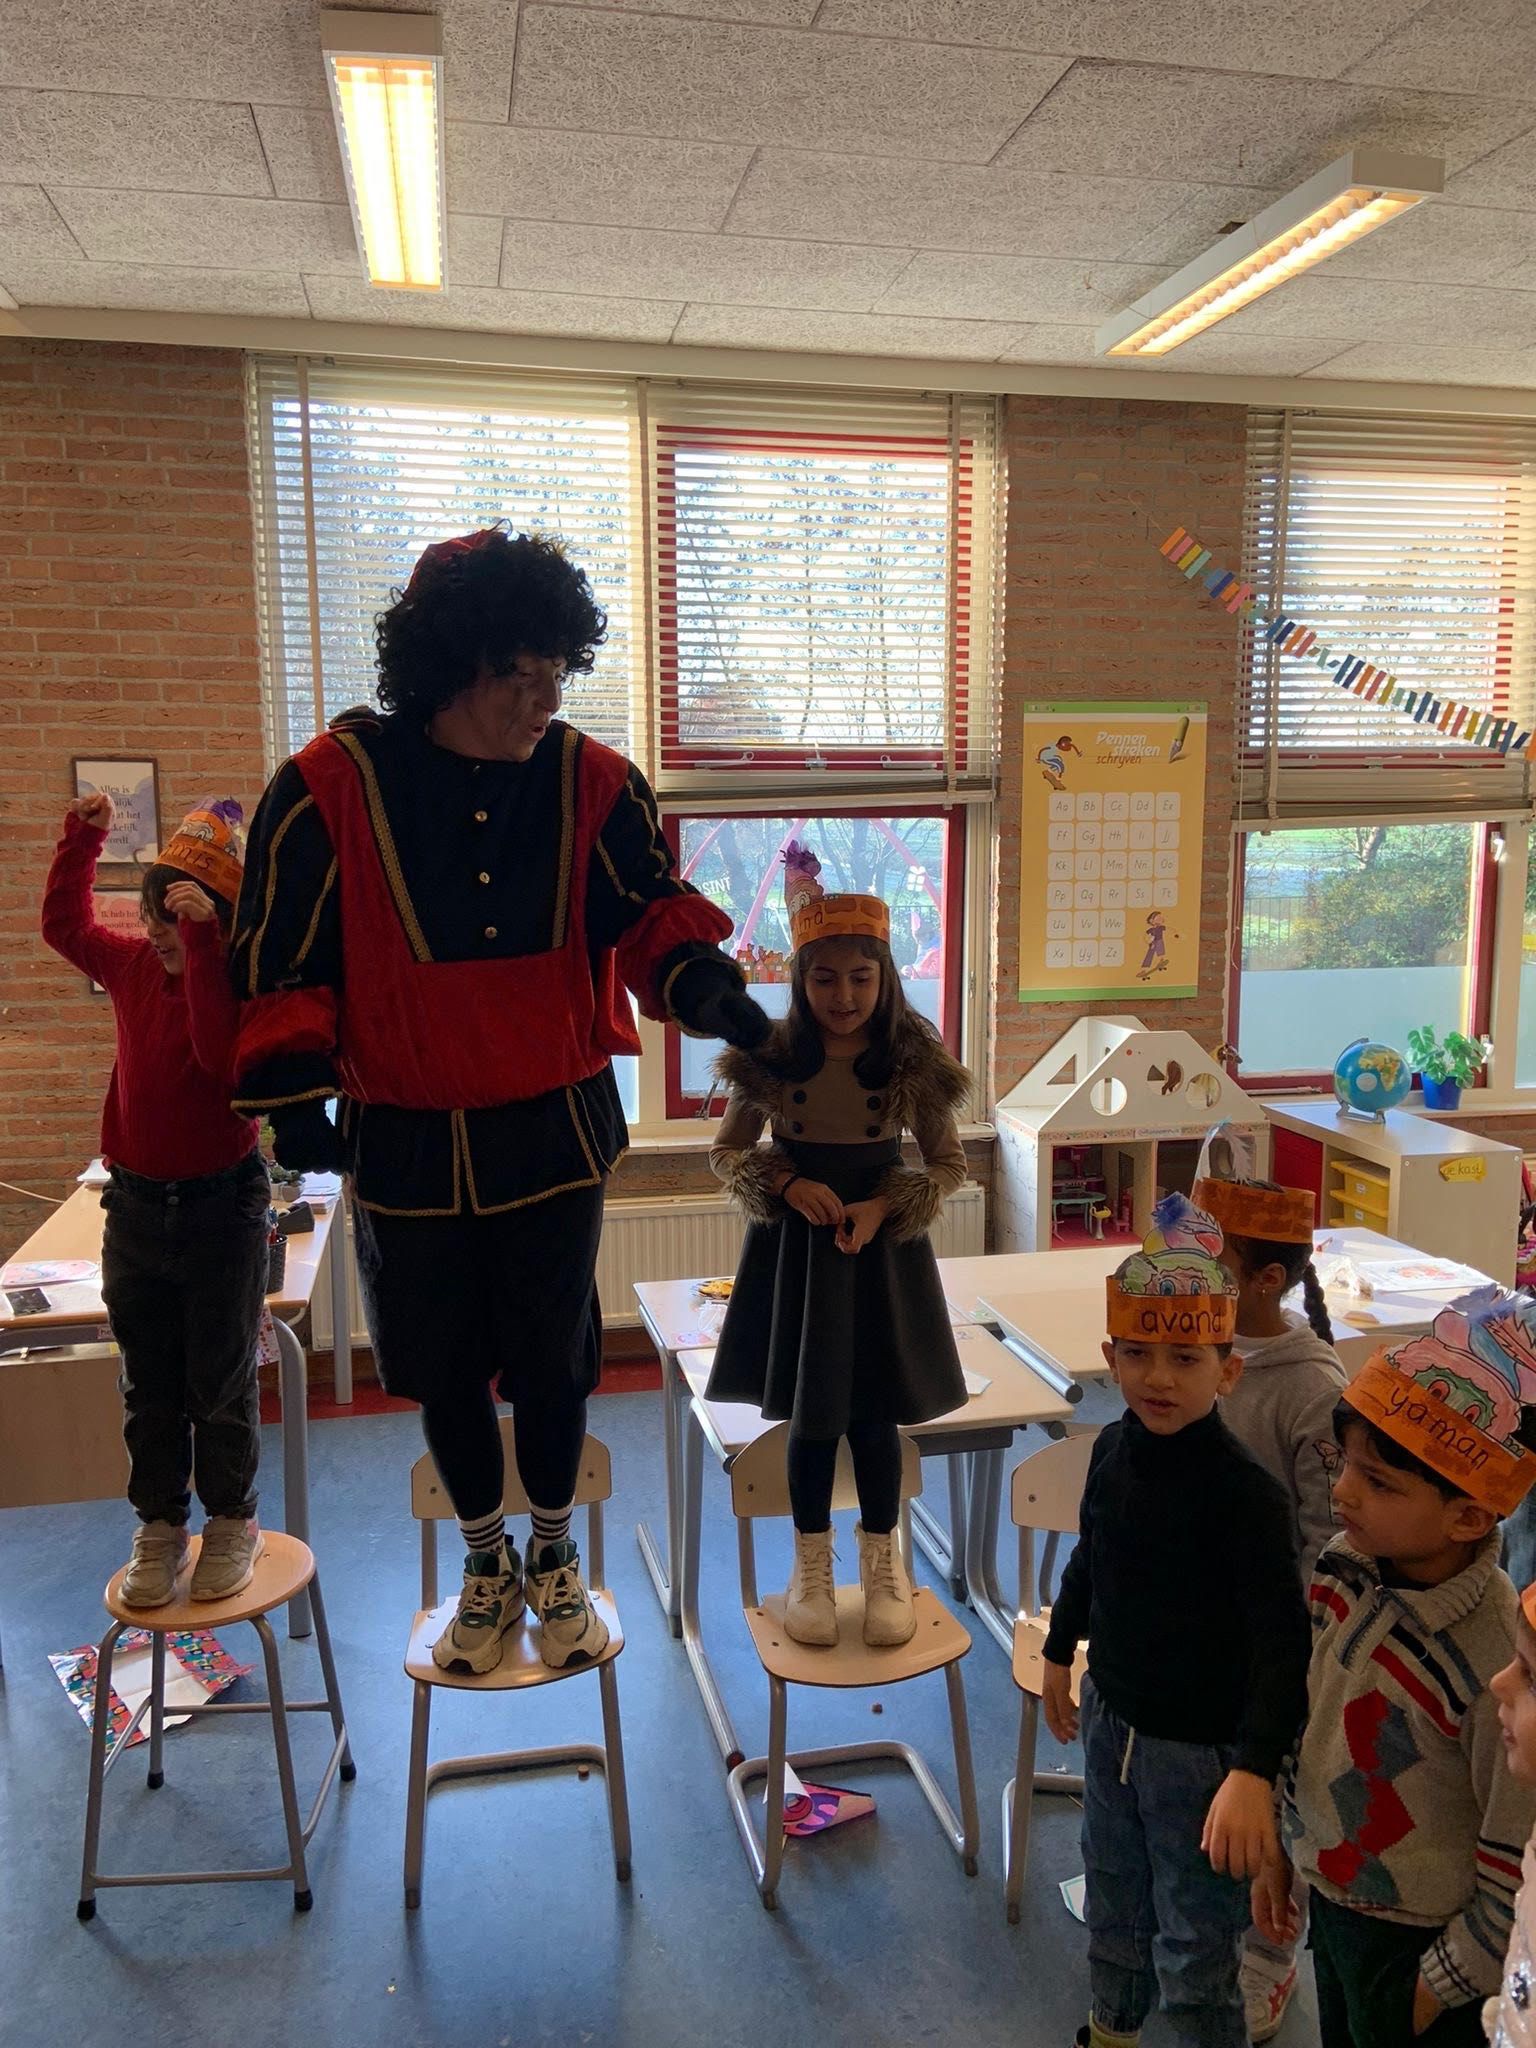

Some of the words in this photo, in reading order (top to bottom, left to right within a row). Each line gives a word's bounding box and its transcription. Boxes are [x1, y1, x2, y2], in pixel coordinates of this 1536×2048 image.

[1095, 731, 1148, 745] Pennen
[1111, 744, 1160, 757] streken
[122, 784, 130, 793] is
[1056, 801, 1069, 811] Aa
[1083, 800, 1096, 811] Bb
[1110, 800, 1123, 811] Cc
[1136, 800, 1149, 811] Dd
[1162, 800, 1174, 811] Ee
[1056, 830, 1068, 841] Ff
[1081, 830, 1096, 844] Gg
[1108, 830, 1122, 841] Hh
[1055, 861, 1067, 871] Kk
[1083, 860, 1093, 871] Ll
[1105, 860, 1124, 870] Mm
[1134, 860, 1147, 869] Nn
[1160, 859, 1173, 869] Oo
[702, 877, 731, 896] SINT
[1055, 890, 1066, 901] Pp
[1080, 889, 1094, 902] Qq
[1108, 889, 1120, 898] Rr
[1135, 888, 1145, 899] Ss
[1161, 888, 1172, 898] Tt
[1053, 920, 1066, 930] Uu
[1081, 919, 1093, 929] Vv
[1104, 919, 1122, 929] Ww
[1053, 947, 1064, 958] Xx
[1079, 947, 1093, 961] Yy
[1105, 947, 1117, 958] Zz
[1458, 1161, 1482, 1176] kast
[1384, 1387, 1489, 1470] yaman
